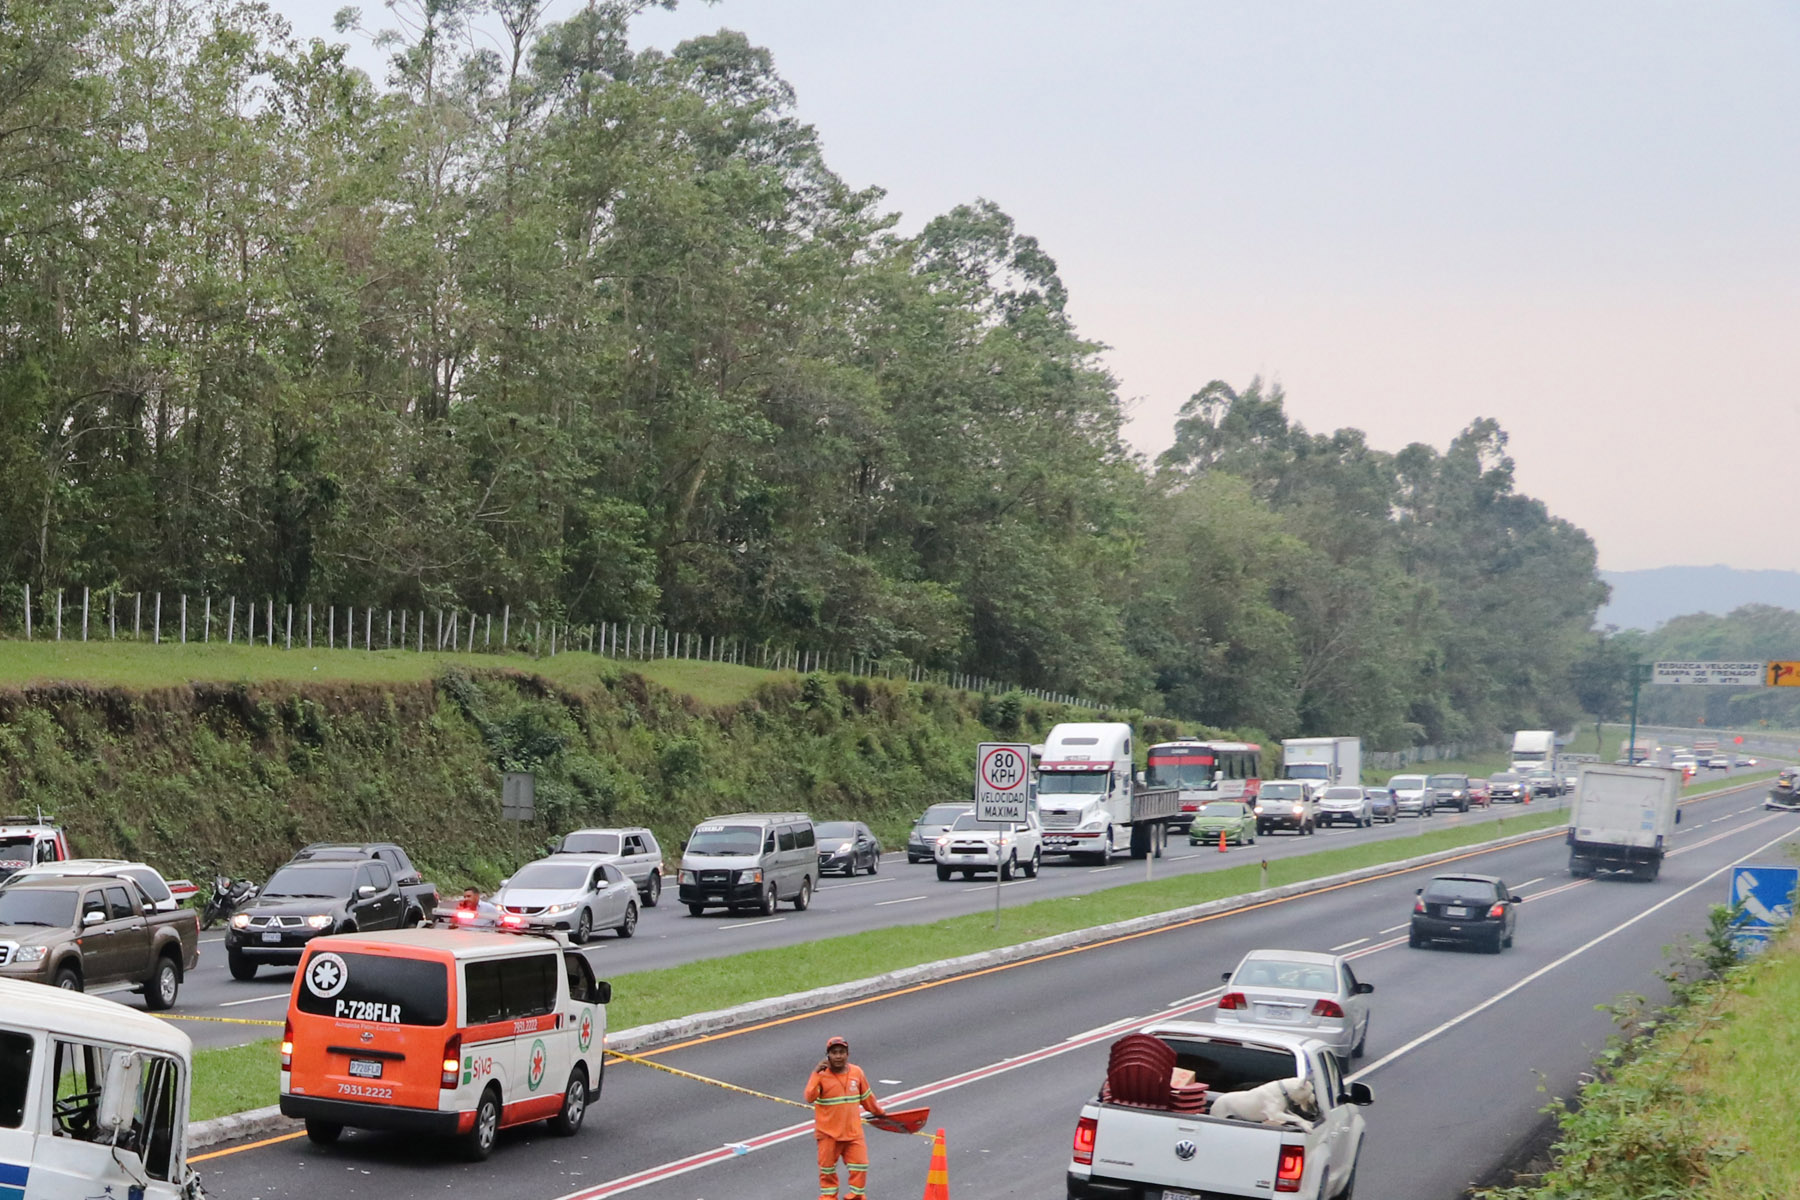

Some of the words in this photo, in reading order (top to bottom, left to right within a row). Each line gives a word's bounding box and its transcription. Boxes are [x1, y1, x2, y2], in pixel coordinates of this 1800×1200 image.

[994, 753, 1014, 769] 80
[991, 769, 1016, 784] KPH
[980, 791, 1024, 804] VELOCIDAD
[984, 806, 1019, 818] MAXIMA
[335, 999, 401, 1024] P-728FLR
[350, 1062, 382, 1075] P728FLR
[337, 1083, 393, 1099] 7931.2222
